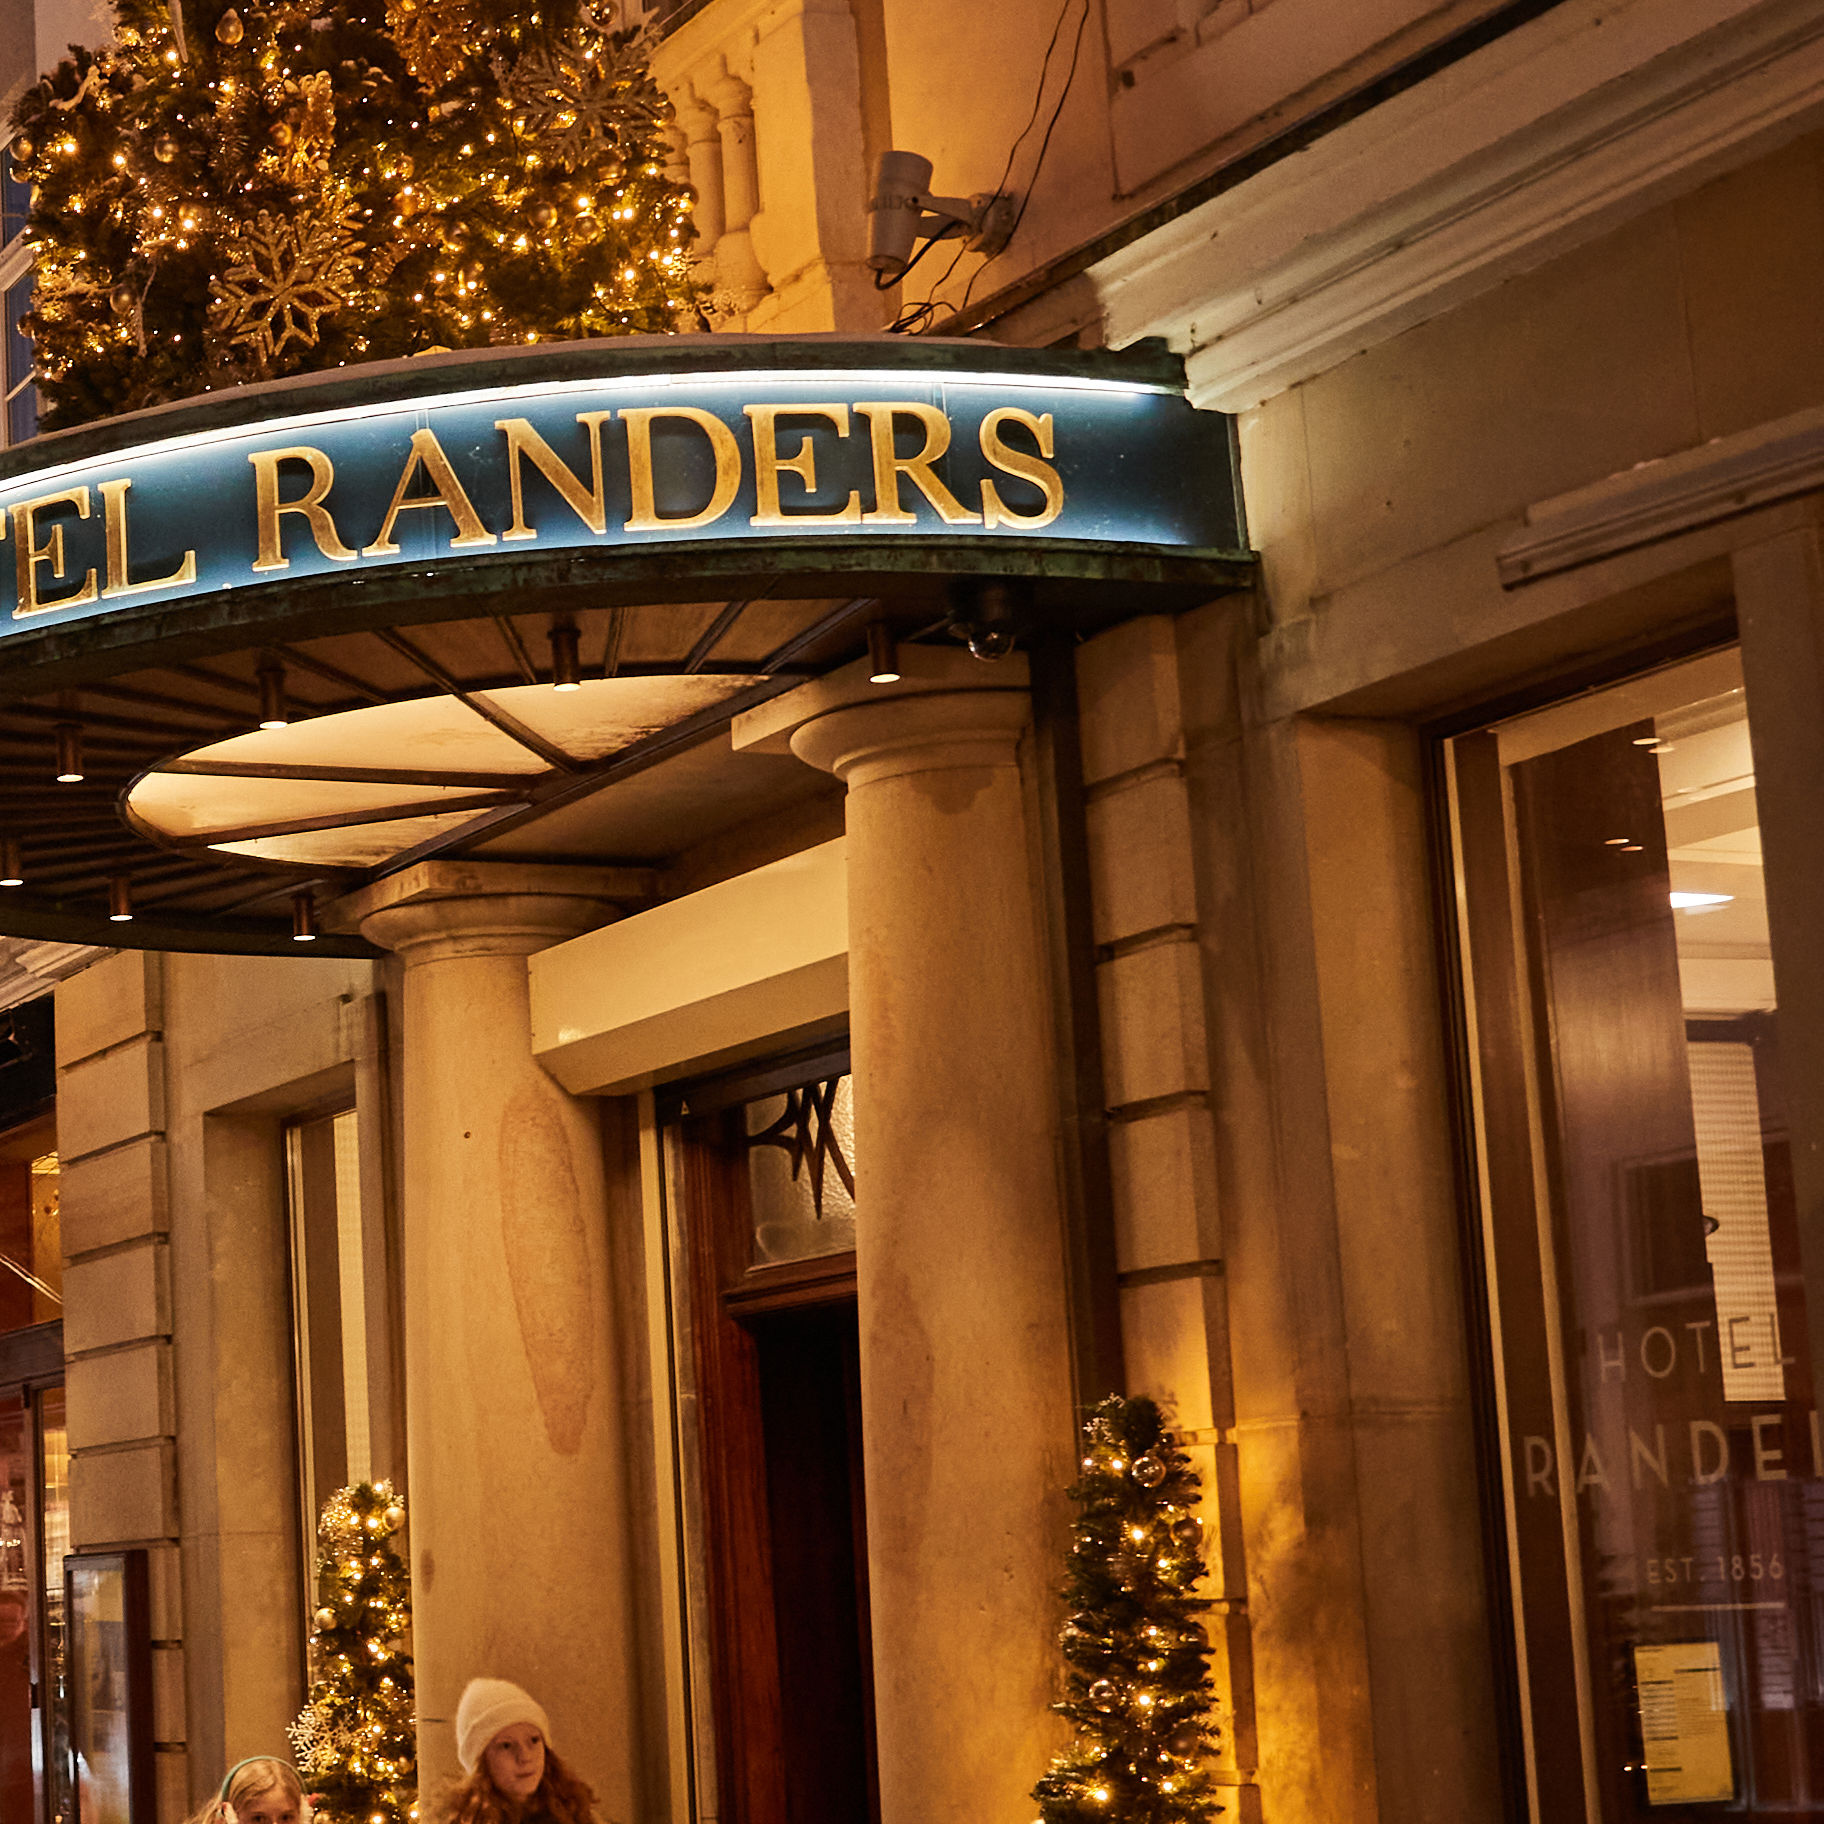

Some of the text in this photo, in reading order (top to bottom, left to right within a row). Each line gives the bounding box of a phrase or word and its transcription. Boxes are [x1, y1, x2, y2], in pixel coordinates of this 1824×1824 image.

[248, 401, 1064, 572] RANDERS
[1597, 1313, 1795, 1382] HOTEL
[1647, 1553, 1784, 1584] EST. 1856
